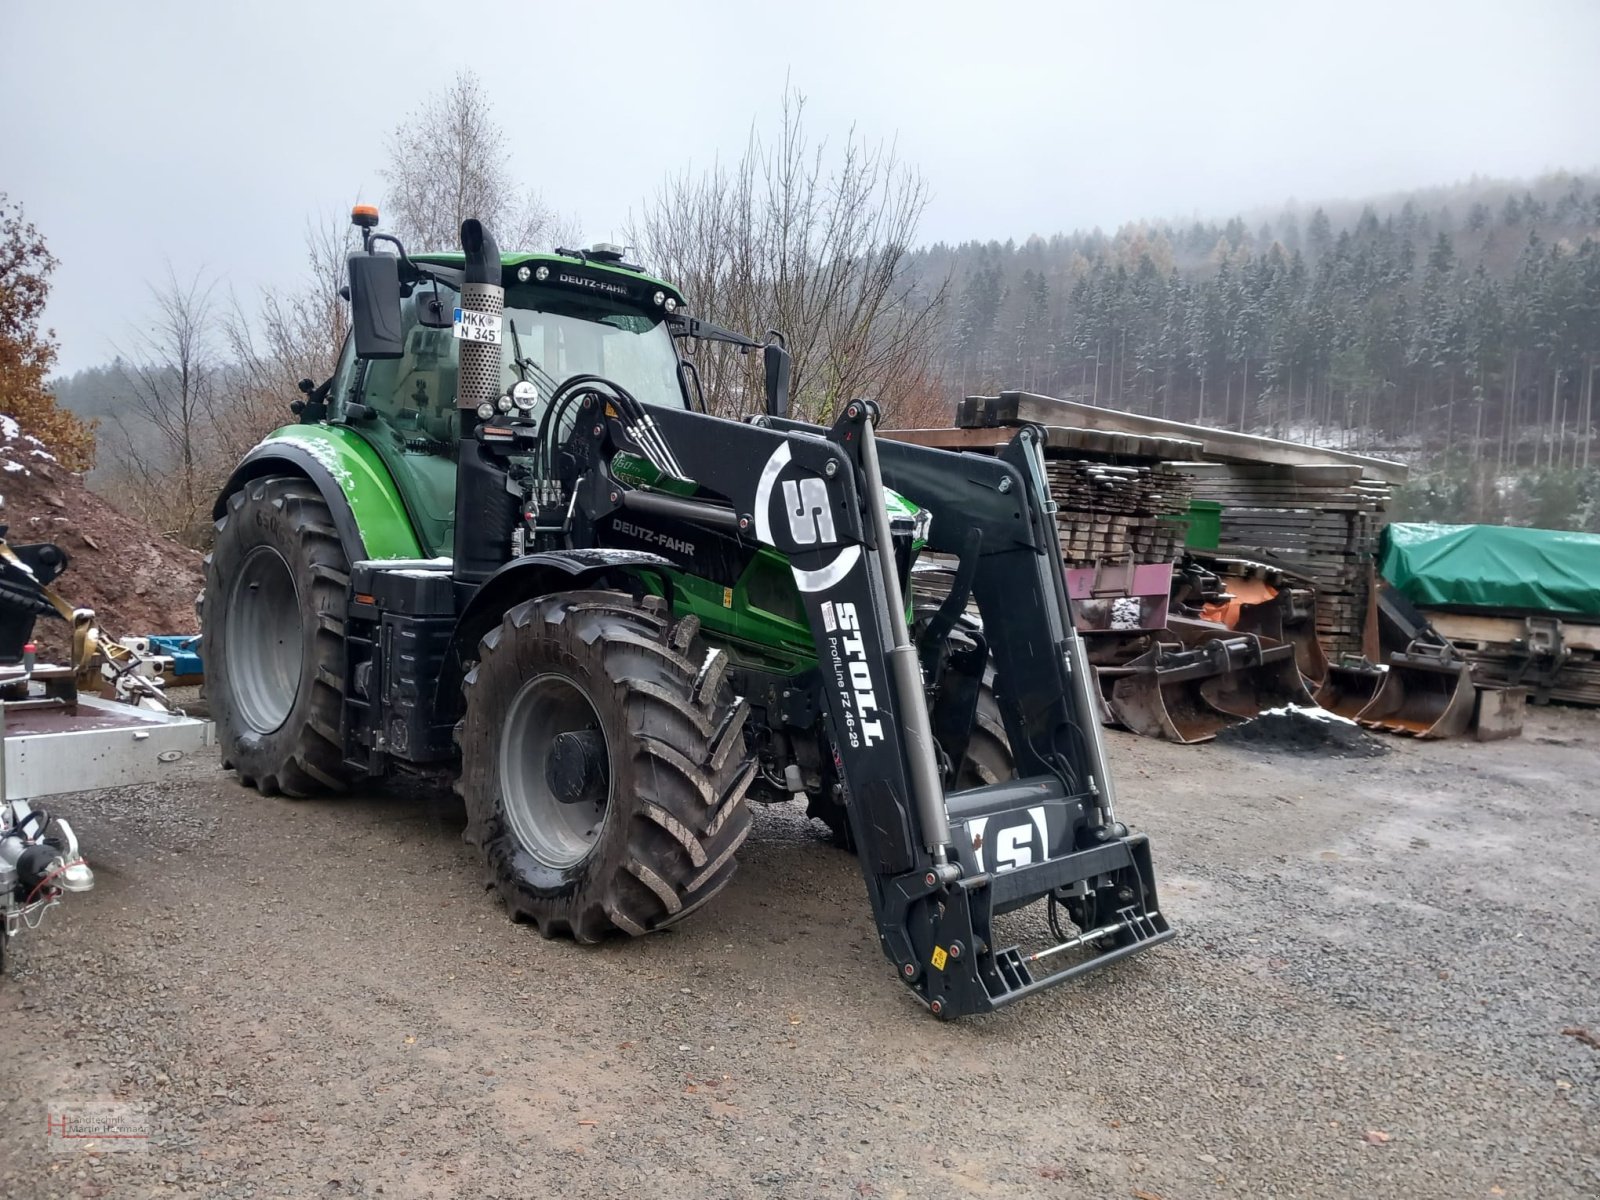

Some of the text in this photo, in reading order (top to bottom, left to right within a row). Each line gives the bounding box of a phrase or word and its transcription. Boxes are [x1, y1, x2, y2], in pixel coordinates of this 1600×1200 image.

[560, 273, 628, 295] DEUTZ-FAHR
[461, 325, 496, 342] N 345
[463, 311, 486, 327] MKK
[781, 477, 837, 544] S
[612, 518, 695, 556] DEUTZ-FAHR
[828, 637, 845, 688] ProfiLine
[835, 602, 885, 747] STOLL
[840, 691, 852, 708] FZ
[844, 711, 859, 748] 46-29
